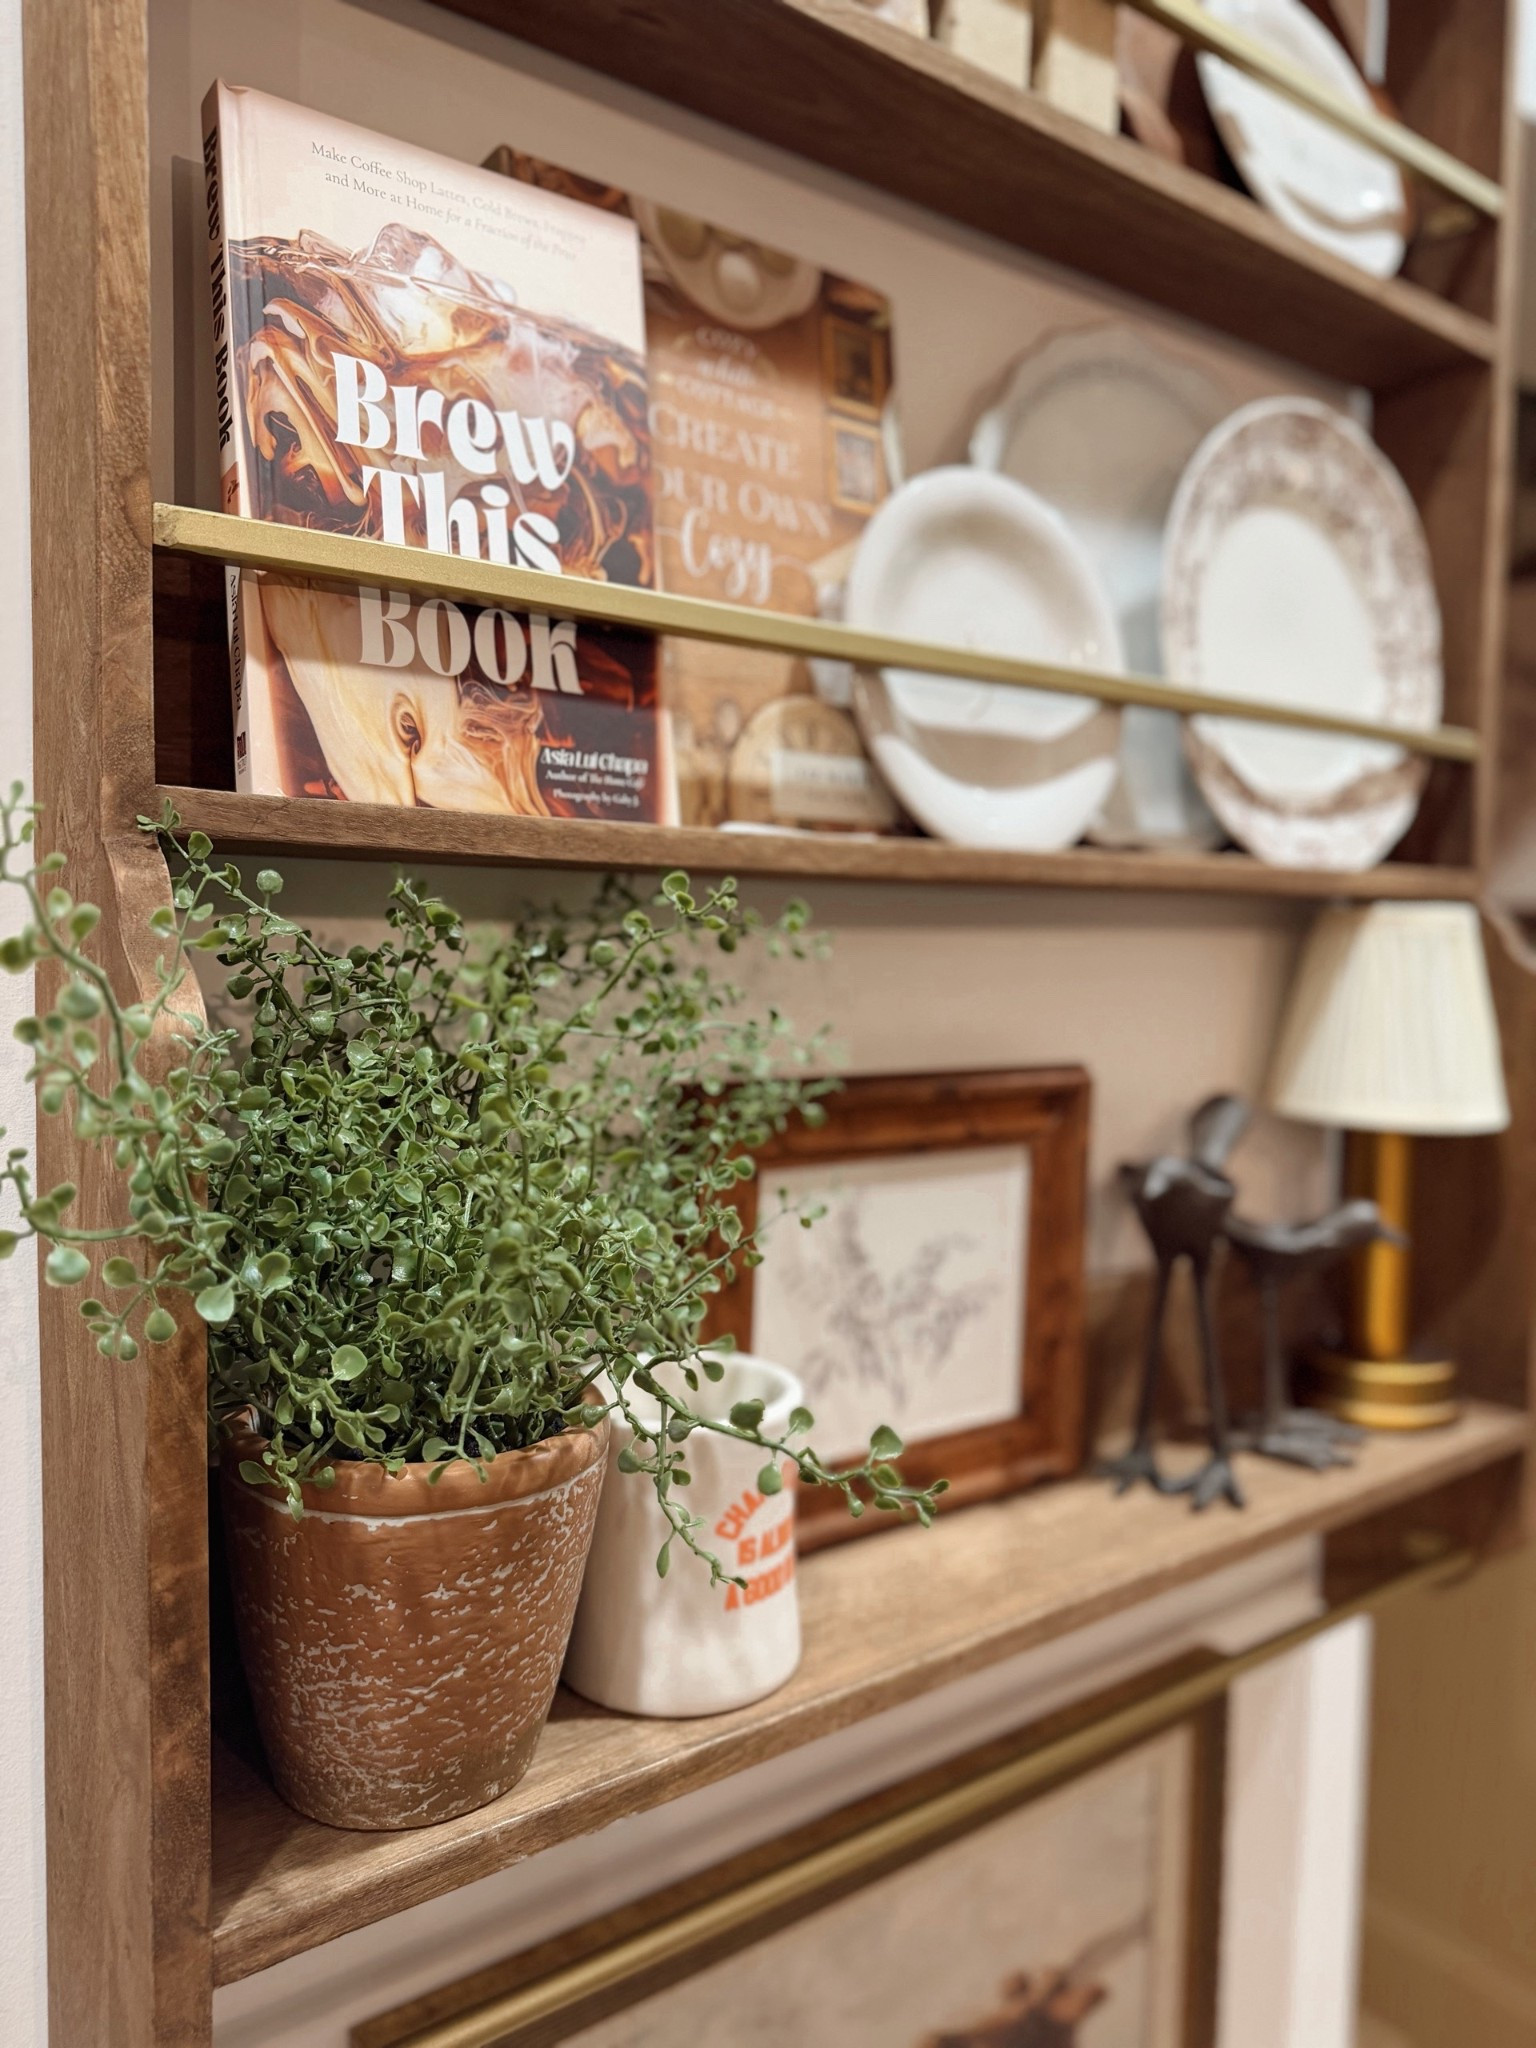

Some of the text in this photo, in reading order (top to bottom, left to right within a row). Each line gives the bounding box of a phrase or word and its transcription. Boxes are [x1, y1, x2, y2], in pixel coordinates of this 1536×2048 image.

[311, 141, 347, 164] Make
[351, 155, 392, 179] Coffee
[396, 170, 427, 193] Shop
[431, 181, 470, 207] Lattes,
[473, 196, 502, 216] Cold
[325, 172, 349, 187] and
[353, 178, 387, 199] More
[390, 192, 402, 204] at
[406, 195, 443, 218] Home
[445, 208, 461, 223] for
[464, 218, 472, 227] a
[203, 126, 233, 452] Brew This Book
[331, 351, 575, 491] Brew
[647, 400, 802, 479] CREATE
[362, 465, 562, 574] This
[738, 480, 831, 540] OWN
[681, 507, 773, 605] Cozy
[358, 585, 584, 696] Book
[540, 747, 575, 767] Asia
